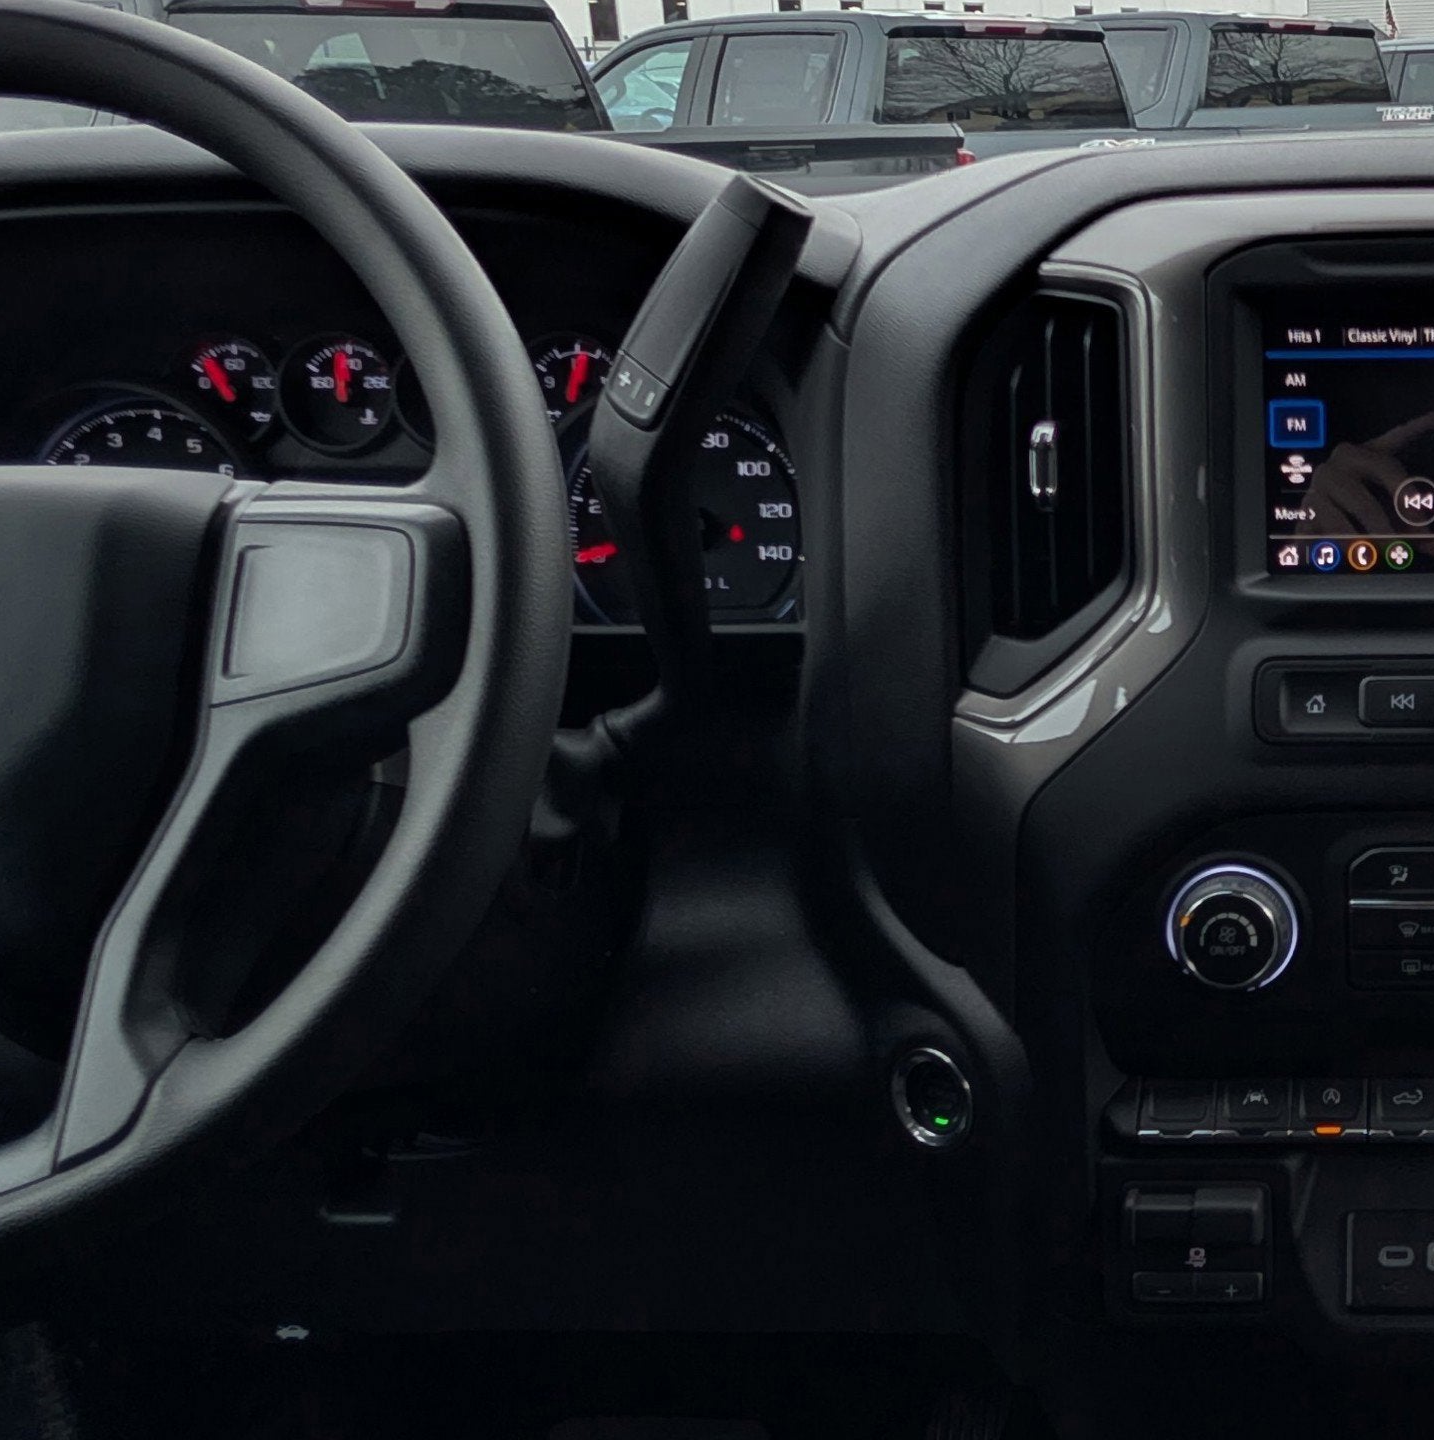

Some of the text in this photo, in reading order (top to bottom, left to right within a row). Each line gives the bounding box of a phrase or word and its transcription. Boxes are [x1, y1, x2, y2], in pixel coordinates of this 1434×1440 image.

[1288, 329, 1312, 343] Hits
[1348, 328, 1417, 345] Classic Vinyl
[1285, 373, 1307, 387] AM
[1287, 418, 1307, 432] FM
[107, 433, 123, 448] 3
[147, 427, 163, 441] 4
[186, 439, 203, 453] 5
[736, 461, 771, 476] 100
[758, 503, 793, 518] 120
[1275, 508, 1307, 520] More
[757, 545, 793, 561] 140
